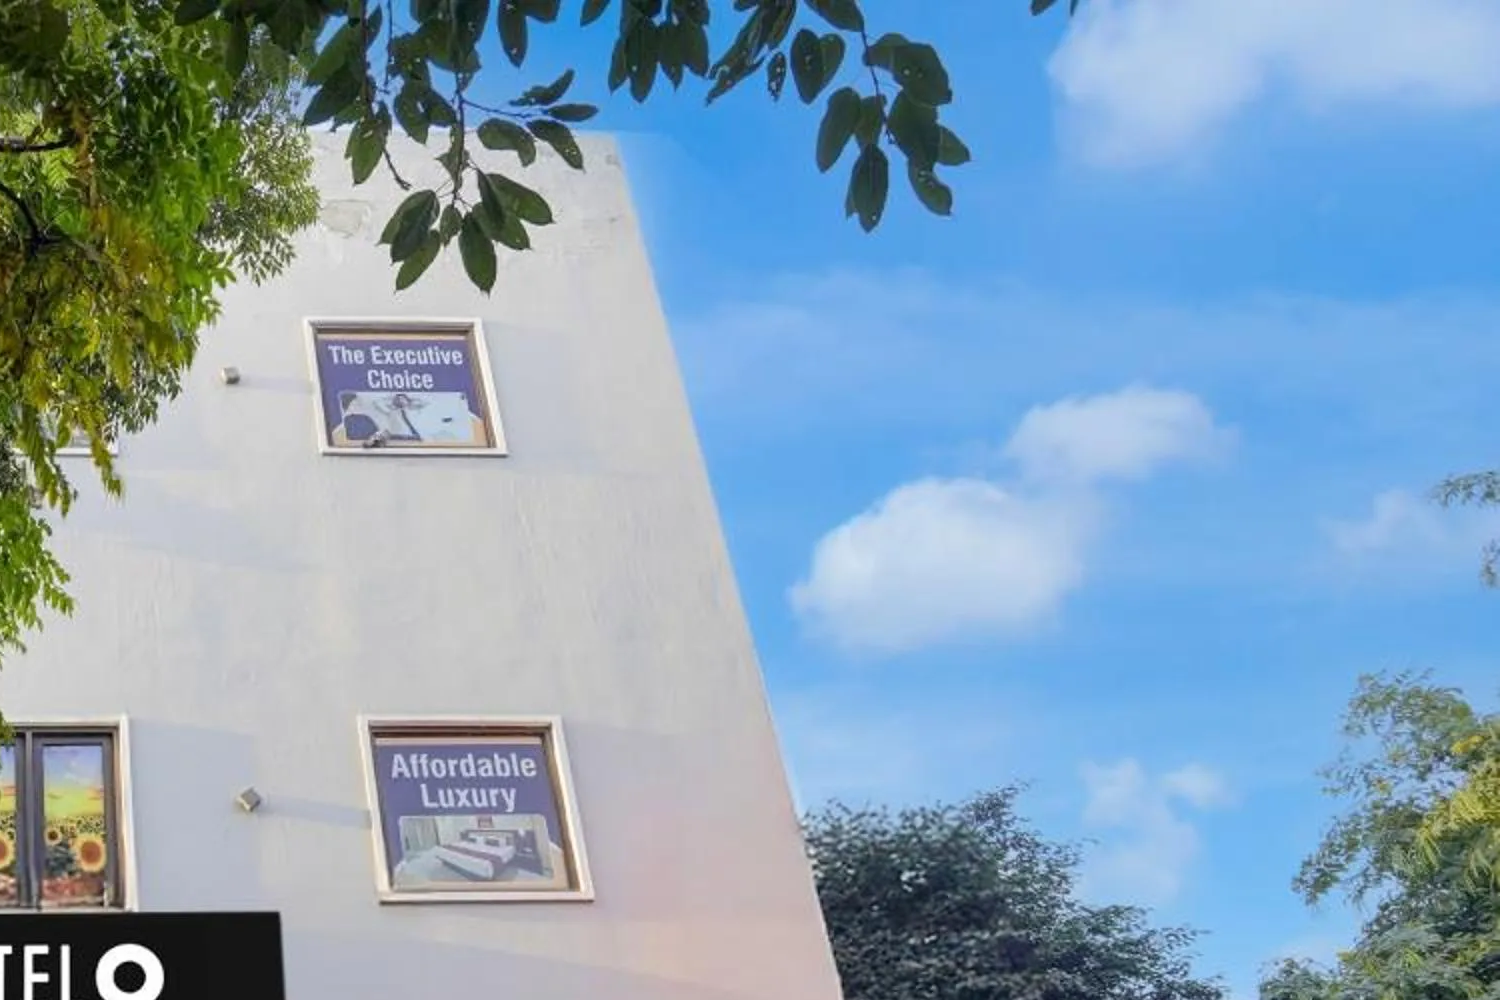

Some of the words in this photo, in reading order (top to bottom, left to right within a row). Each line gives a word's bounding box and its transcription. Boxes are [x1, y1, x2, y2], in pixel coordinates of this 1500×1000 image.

[329, 345, 364, 364] The
[371, 346, 463, 365] Executive
[367, 369, 434, 389] Choice
[391, 753, 537, 779] Affordable
[420, 783, 516, 812] Luxury
